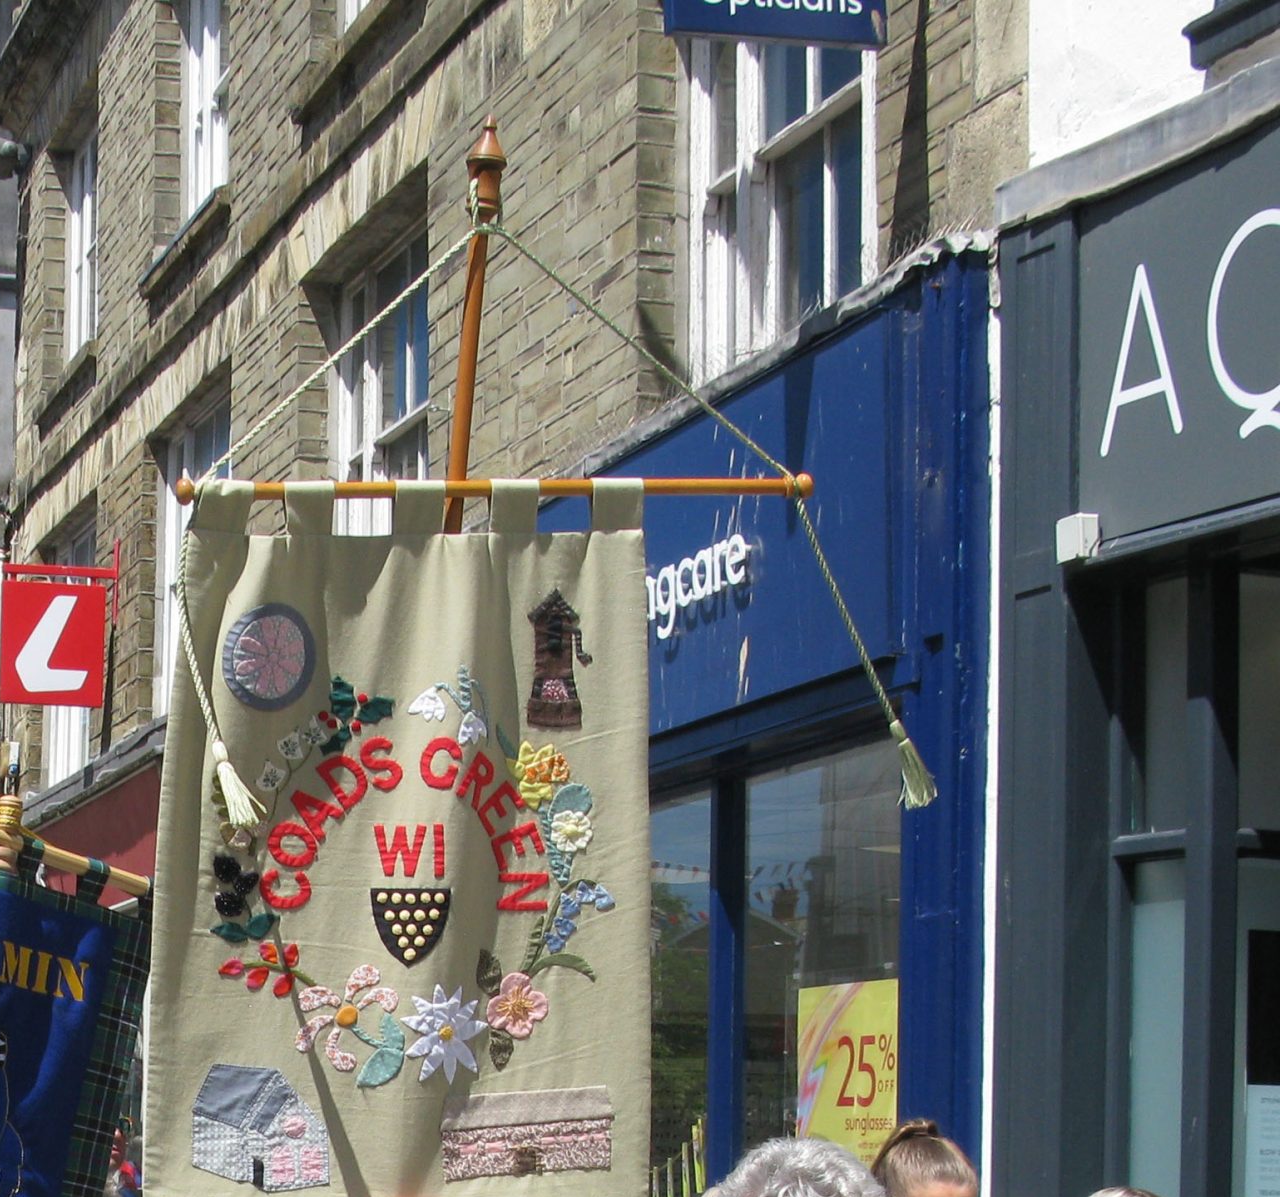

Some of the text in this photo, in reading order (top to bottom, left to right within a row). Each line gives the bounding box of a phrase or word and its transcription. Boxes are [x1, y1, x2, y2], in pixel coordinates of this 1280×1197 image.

[259, 736, 549, 911] COADS GREEN
[373, 823, 445, 878] WI
[836, 1034, 895, 1108] 25%
[878, 1080, 894, 1093] OFF
[845, 1113, 893, 1136] sunglasses
